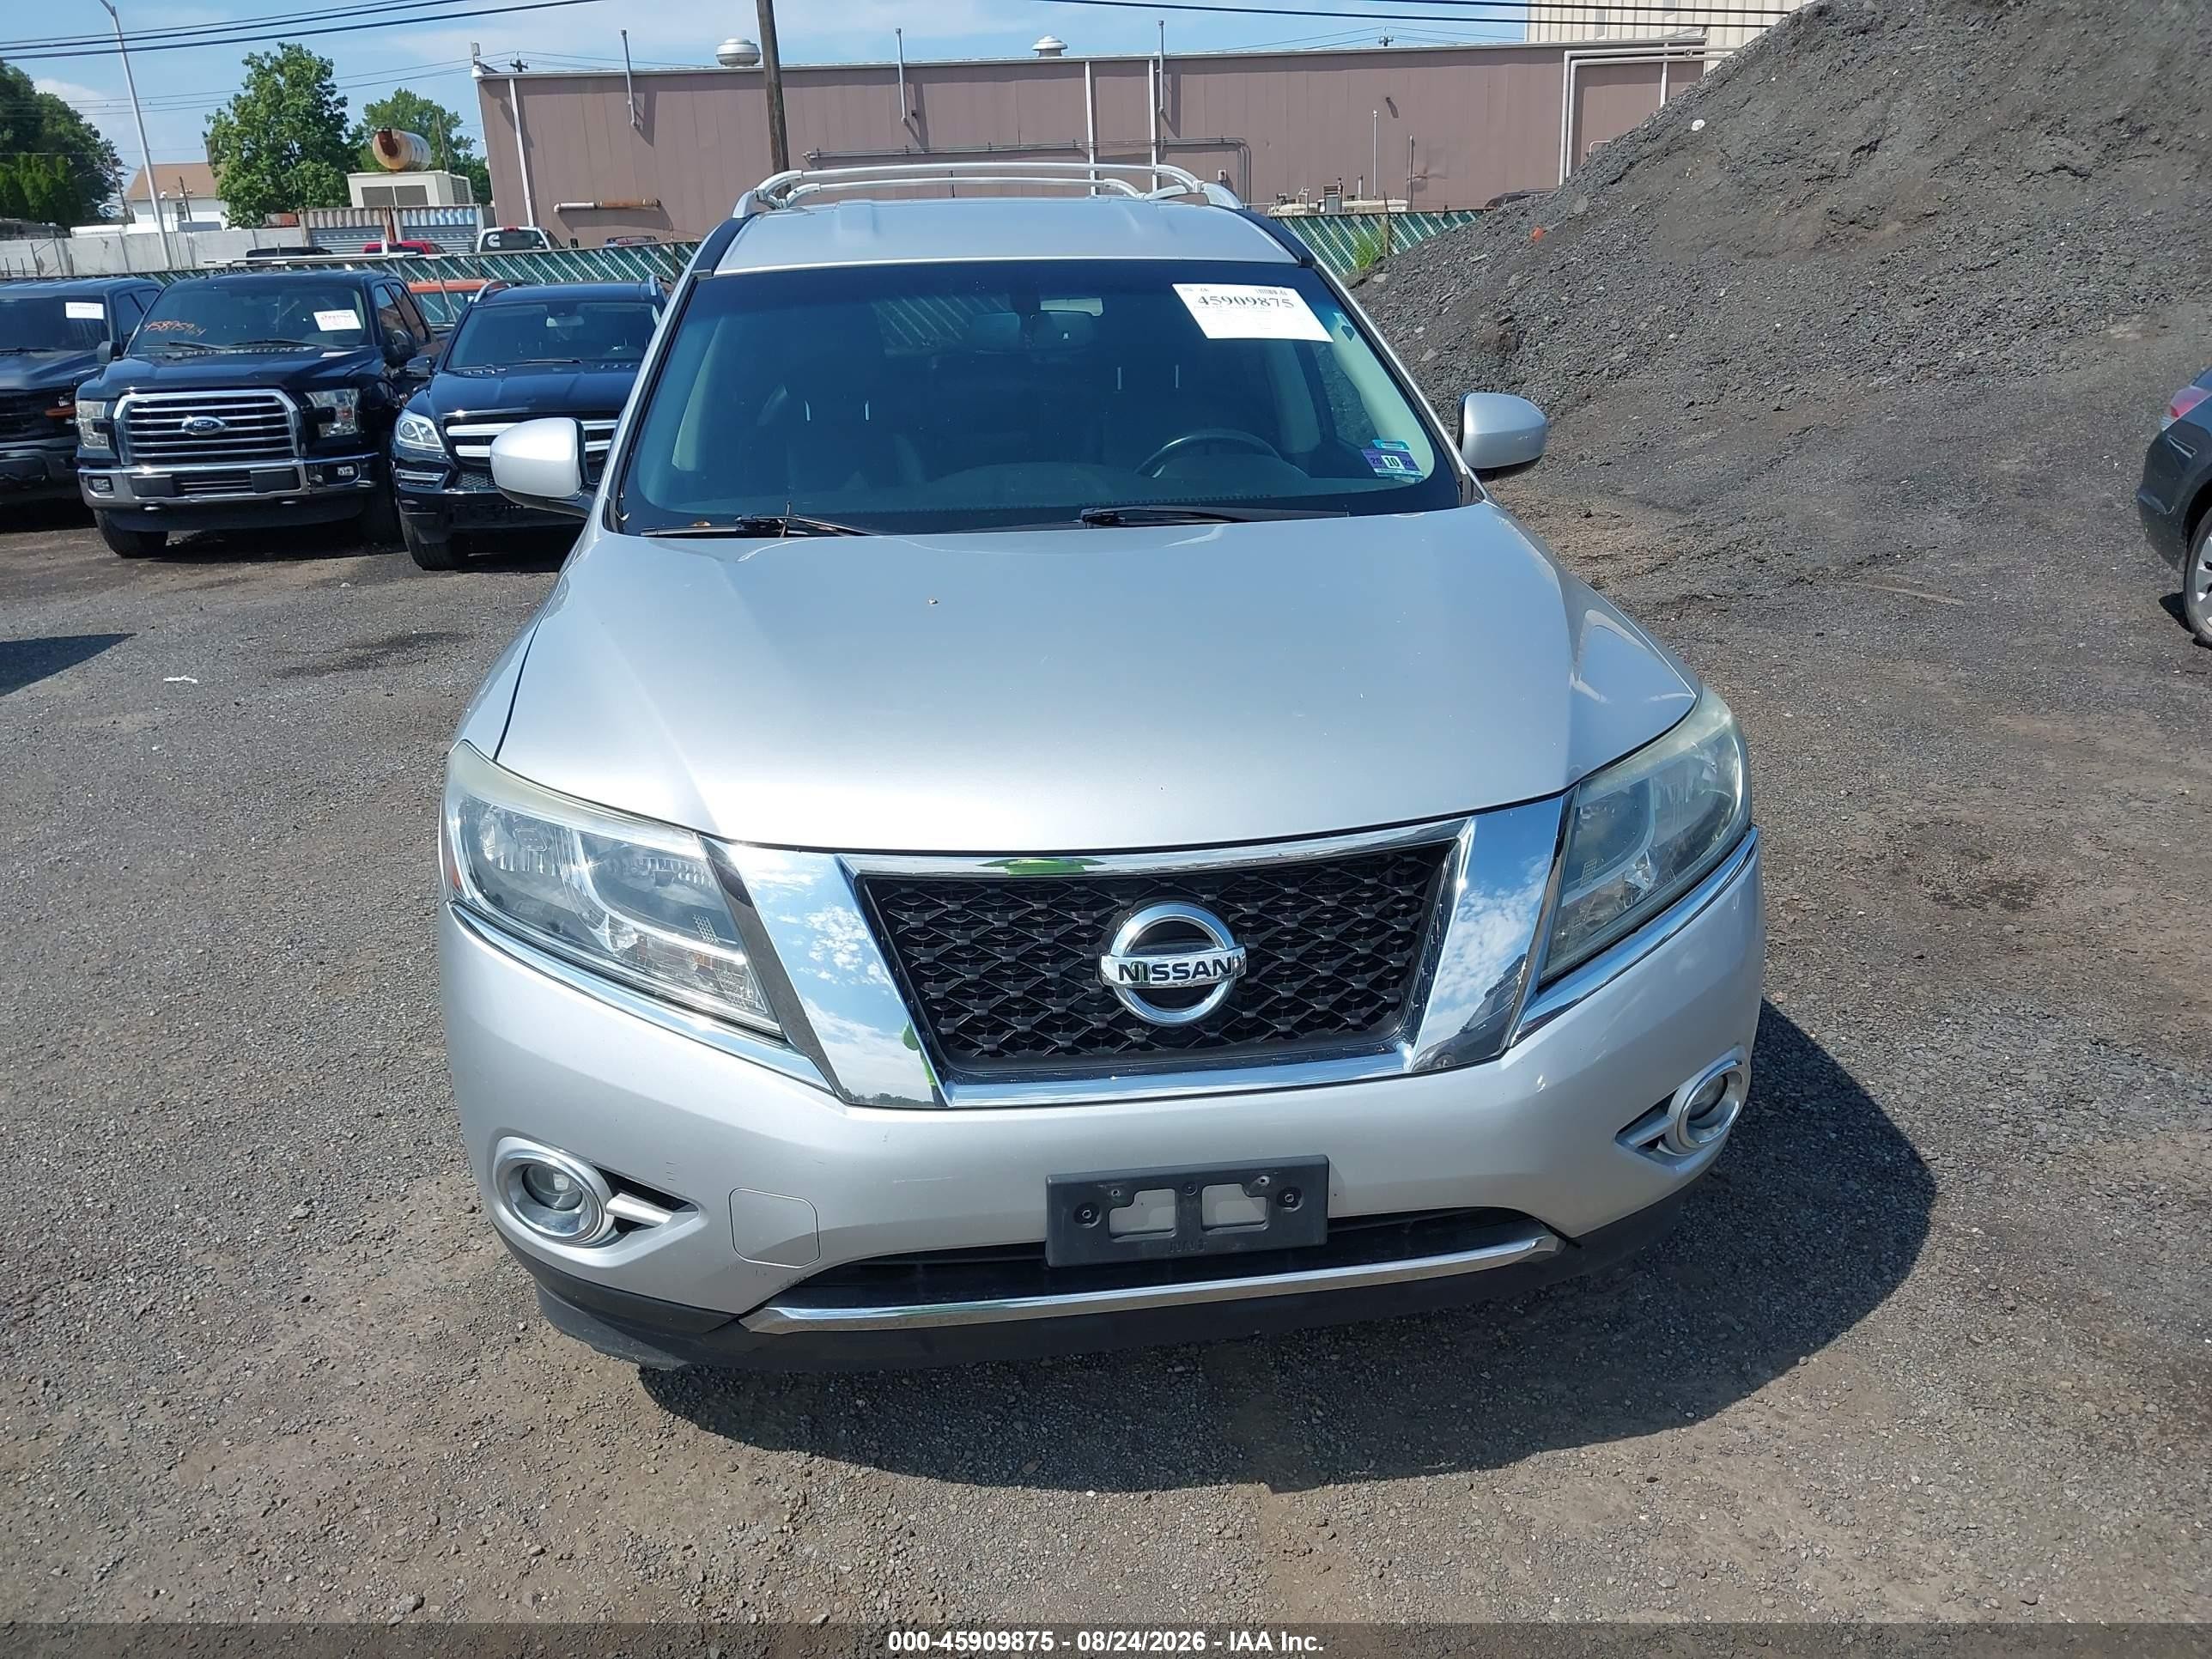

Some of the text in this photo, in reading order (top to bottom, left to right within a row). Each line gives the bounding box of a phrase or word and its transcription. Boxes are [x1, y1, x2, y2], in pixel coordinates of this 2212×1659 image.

[1197, 295, 1295, 309] 45909875
[1384, 456, 1401, 468] 10
[1117, 956, 1232, 982] NISSAN
